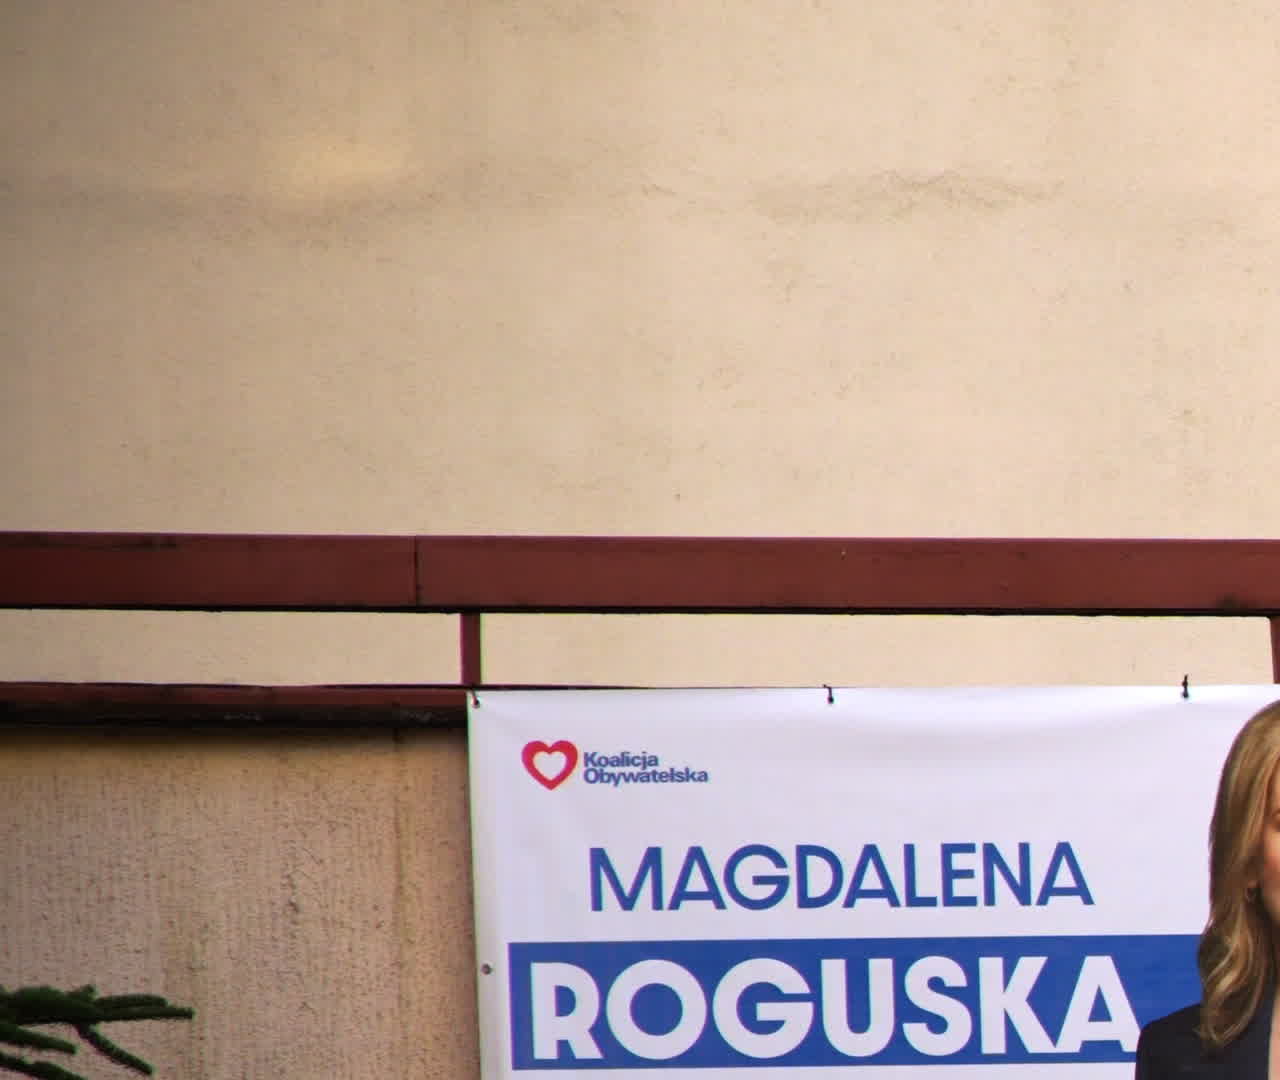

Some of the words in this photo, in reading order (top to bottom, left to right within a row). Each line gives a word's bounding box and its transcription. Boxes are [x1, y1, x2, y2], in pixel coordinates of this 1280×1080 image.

[583, 751, 659, 769] Koalicja
[583, 767, 708, 787] Obywatelska
[589, 841, 1095, 912] MAGDALENA
[529, 954, 1137, 1060] ROGUSKA
